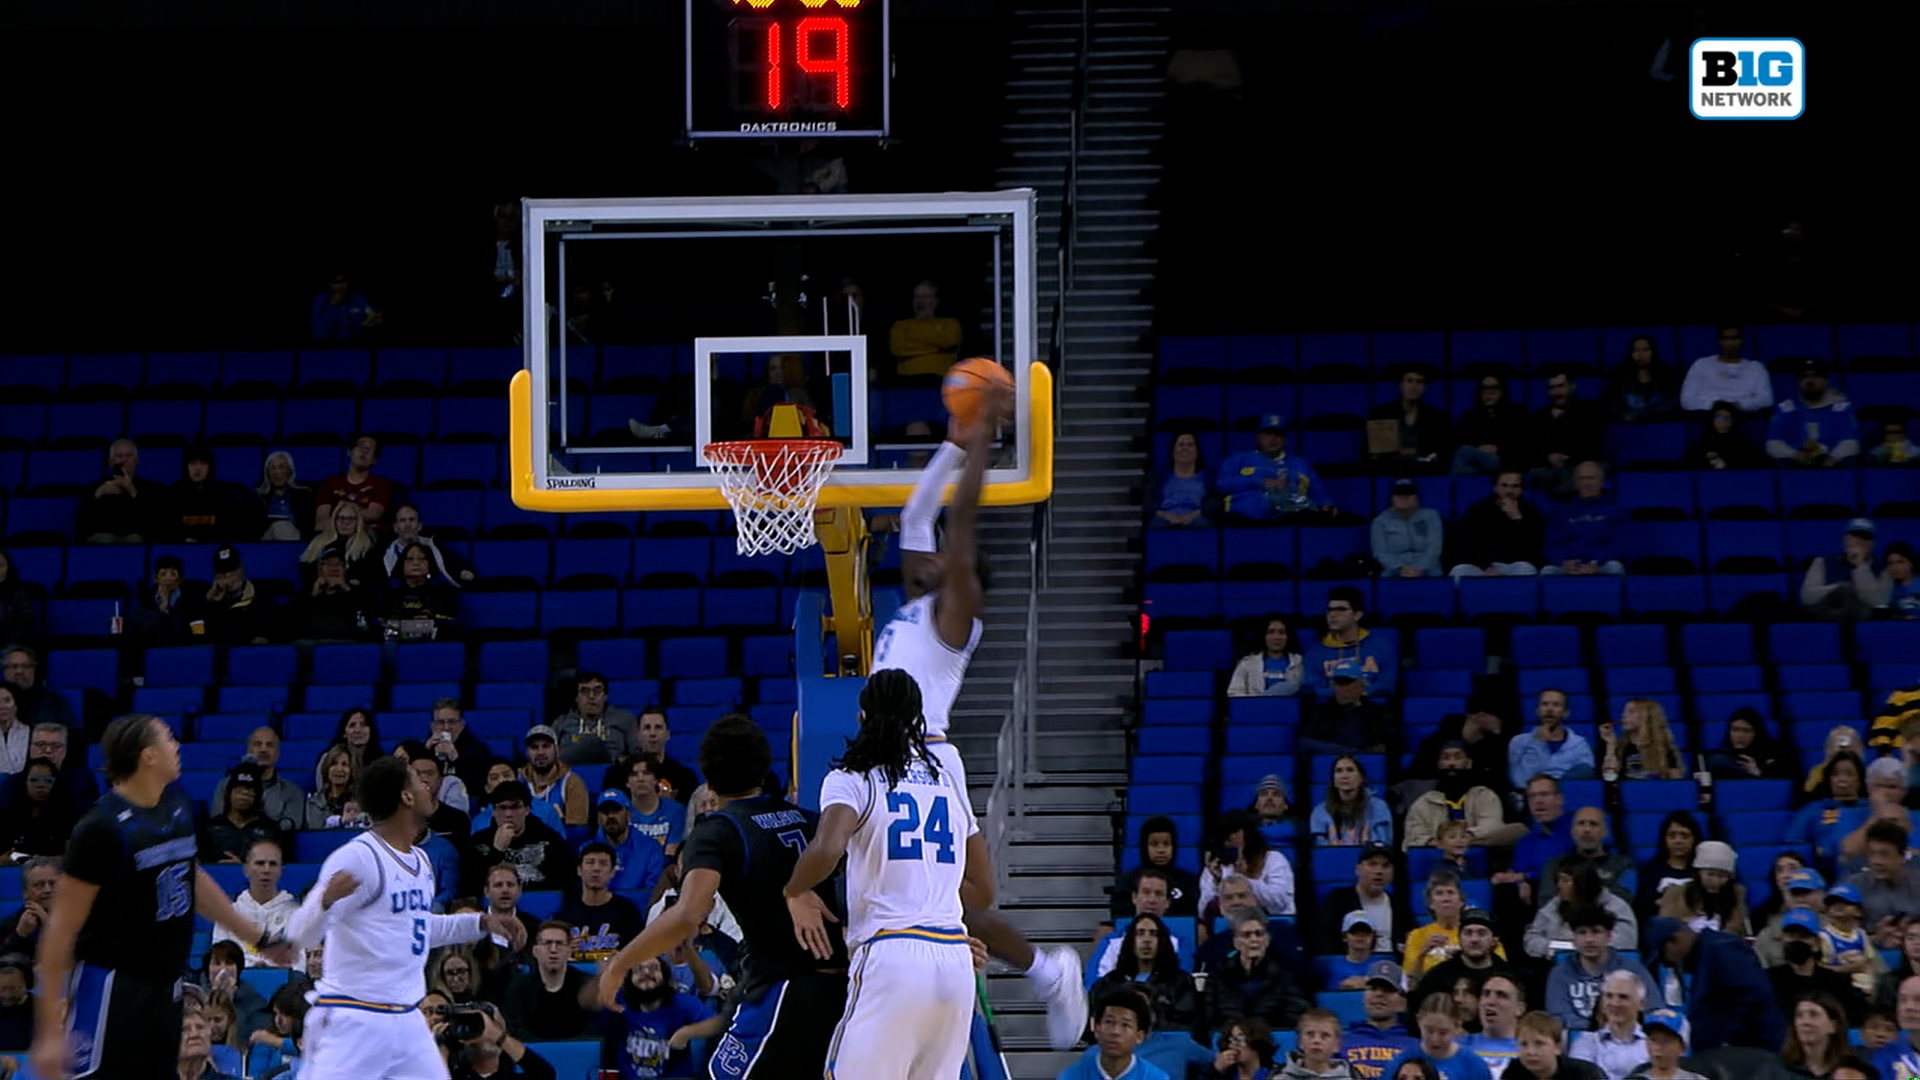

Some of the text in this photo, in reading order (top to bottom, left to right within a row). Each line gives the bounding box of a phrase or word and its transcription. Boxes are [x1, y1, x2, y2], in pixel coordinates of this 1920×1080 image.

[768, 17, 848, 109] 19
[740, 121, 837, 133] DAKTRONICS
[546, 477, 596, 489] SPALDING
[777, 828, 808, 856] 7
[885, 791, 956, 865] 24
[155, 860, 192, 922] 15
[391, 889, 433, 914] UCL
[411, 918, 426, 956] 5
